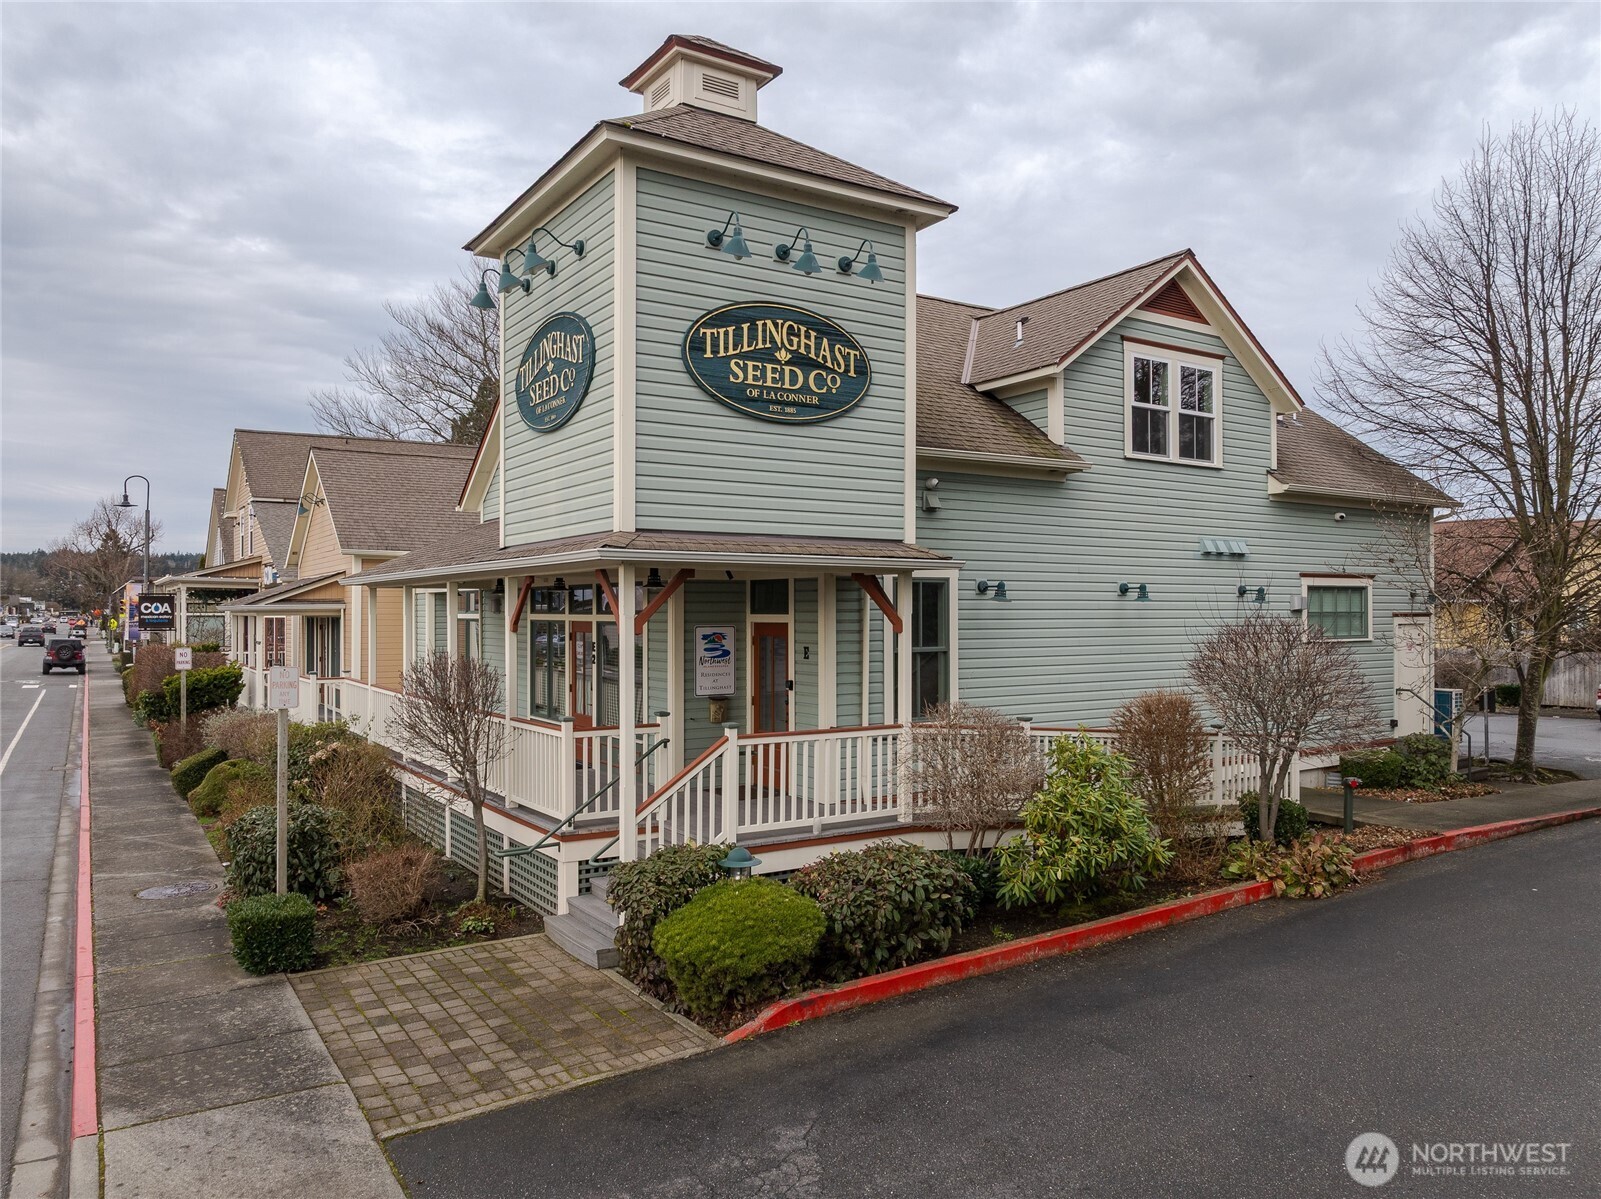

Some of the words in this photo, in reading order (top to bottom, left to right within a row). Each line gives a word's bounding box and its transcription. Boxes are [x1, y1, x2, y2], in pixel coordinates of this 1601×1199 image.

[700, 319, 860, 378] TILLINGHAST
[520, 331, 585, 392] TILLINGHAST
[729, 359, 804, 390] SEED
[529, 374, 559, 406] SEED
[746, 388, 760, 398] OF
[763, 390, 776, 400] LA
[777, 391, 820, 405] CONNER
[769, 405, 783, 413] EST.
[140, 602, 172, 614] COA
[592, 654, 595, 664] 2
[803, 646, 810, 660] E
[699, 656, 731, 665] Northwest
[280, 670, 290, 678] NO
